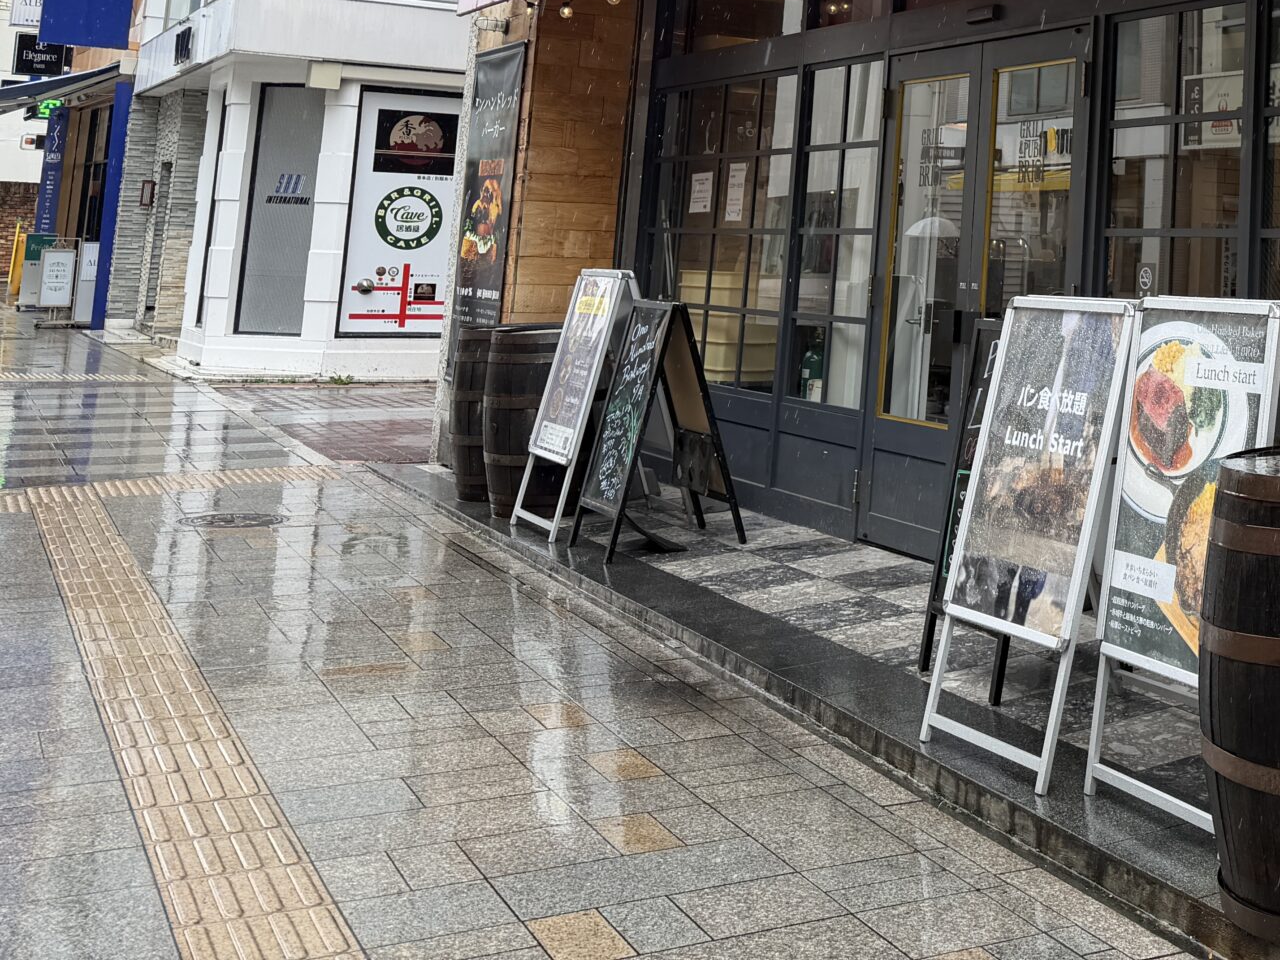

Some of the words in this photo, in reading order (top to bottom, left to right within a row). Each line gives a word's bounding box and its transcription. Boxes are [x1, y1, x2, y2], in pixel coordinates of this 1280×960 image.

[399, 119, 416, 136] 香
[481, 119, 506, 138] バーガー
[265, 195, 311, 206] INTERNATIONAL
[377, 192, 400, 217] BAR
[413, 189, 440, 224] GRILL
[390, 205, 429, 224] Cave
[395, 224, 420, 233] 居酒屋
[387, 234, 430, 248] CAVE
[1196, 362, 1230, 383] Lunch
[1232, 367, 1257, 385] start
[1004, 425, 1044, 451] Lunch
[1050, 431, 1084, 458] Start
